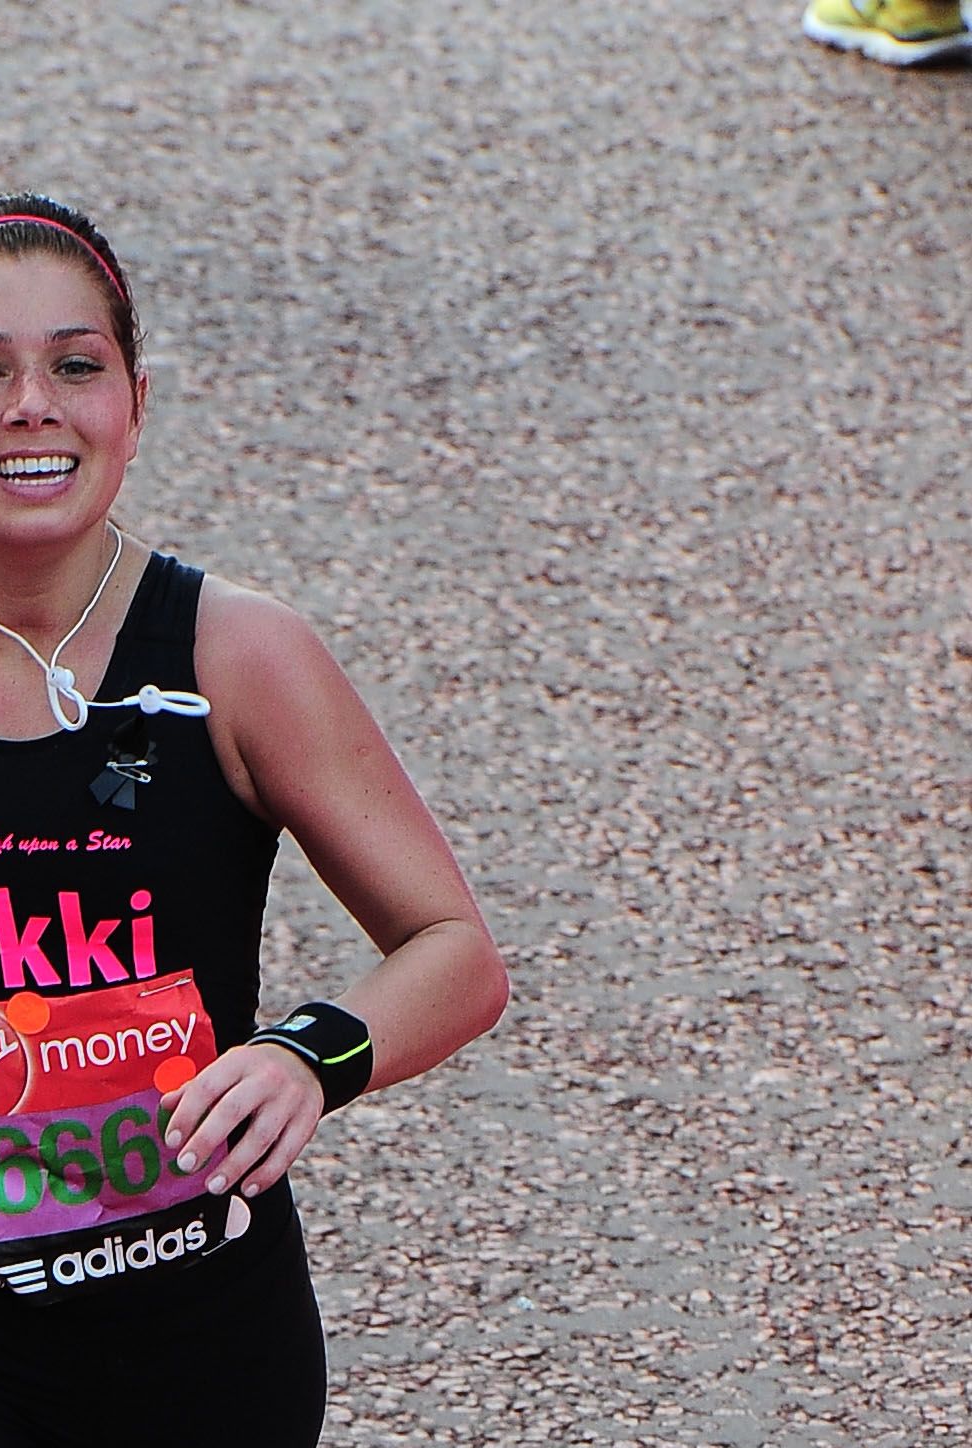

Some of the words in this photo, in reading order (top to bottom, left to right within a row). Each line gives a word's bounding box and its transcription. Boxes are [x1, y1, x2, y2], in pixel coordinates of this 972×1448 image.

[18, 837, 60, 855] upon
[65, 838, 78, 851] a
[85, 830, 132, 851] Star
[40, 1012, 197, 1074] money
[51, 1219, 208, 1286] adidas
